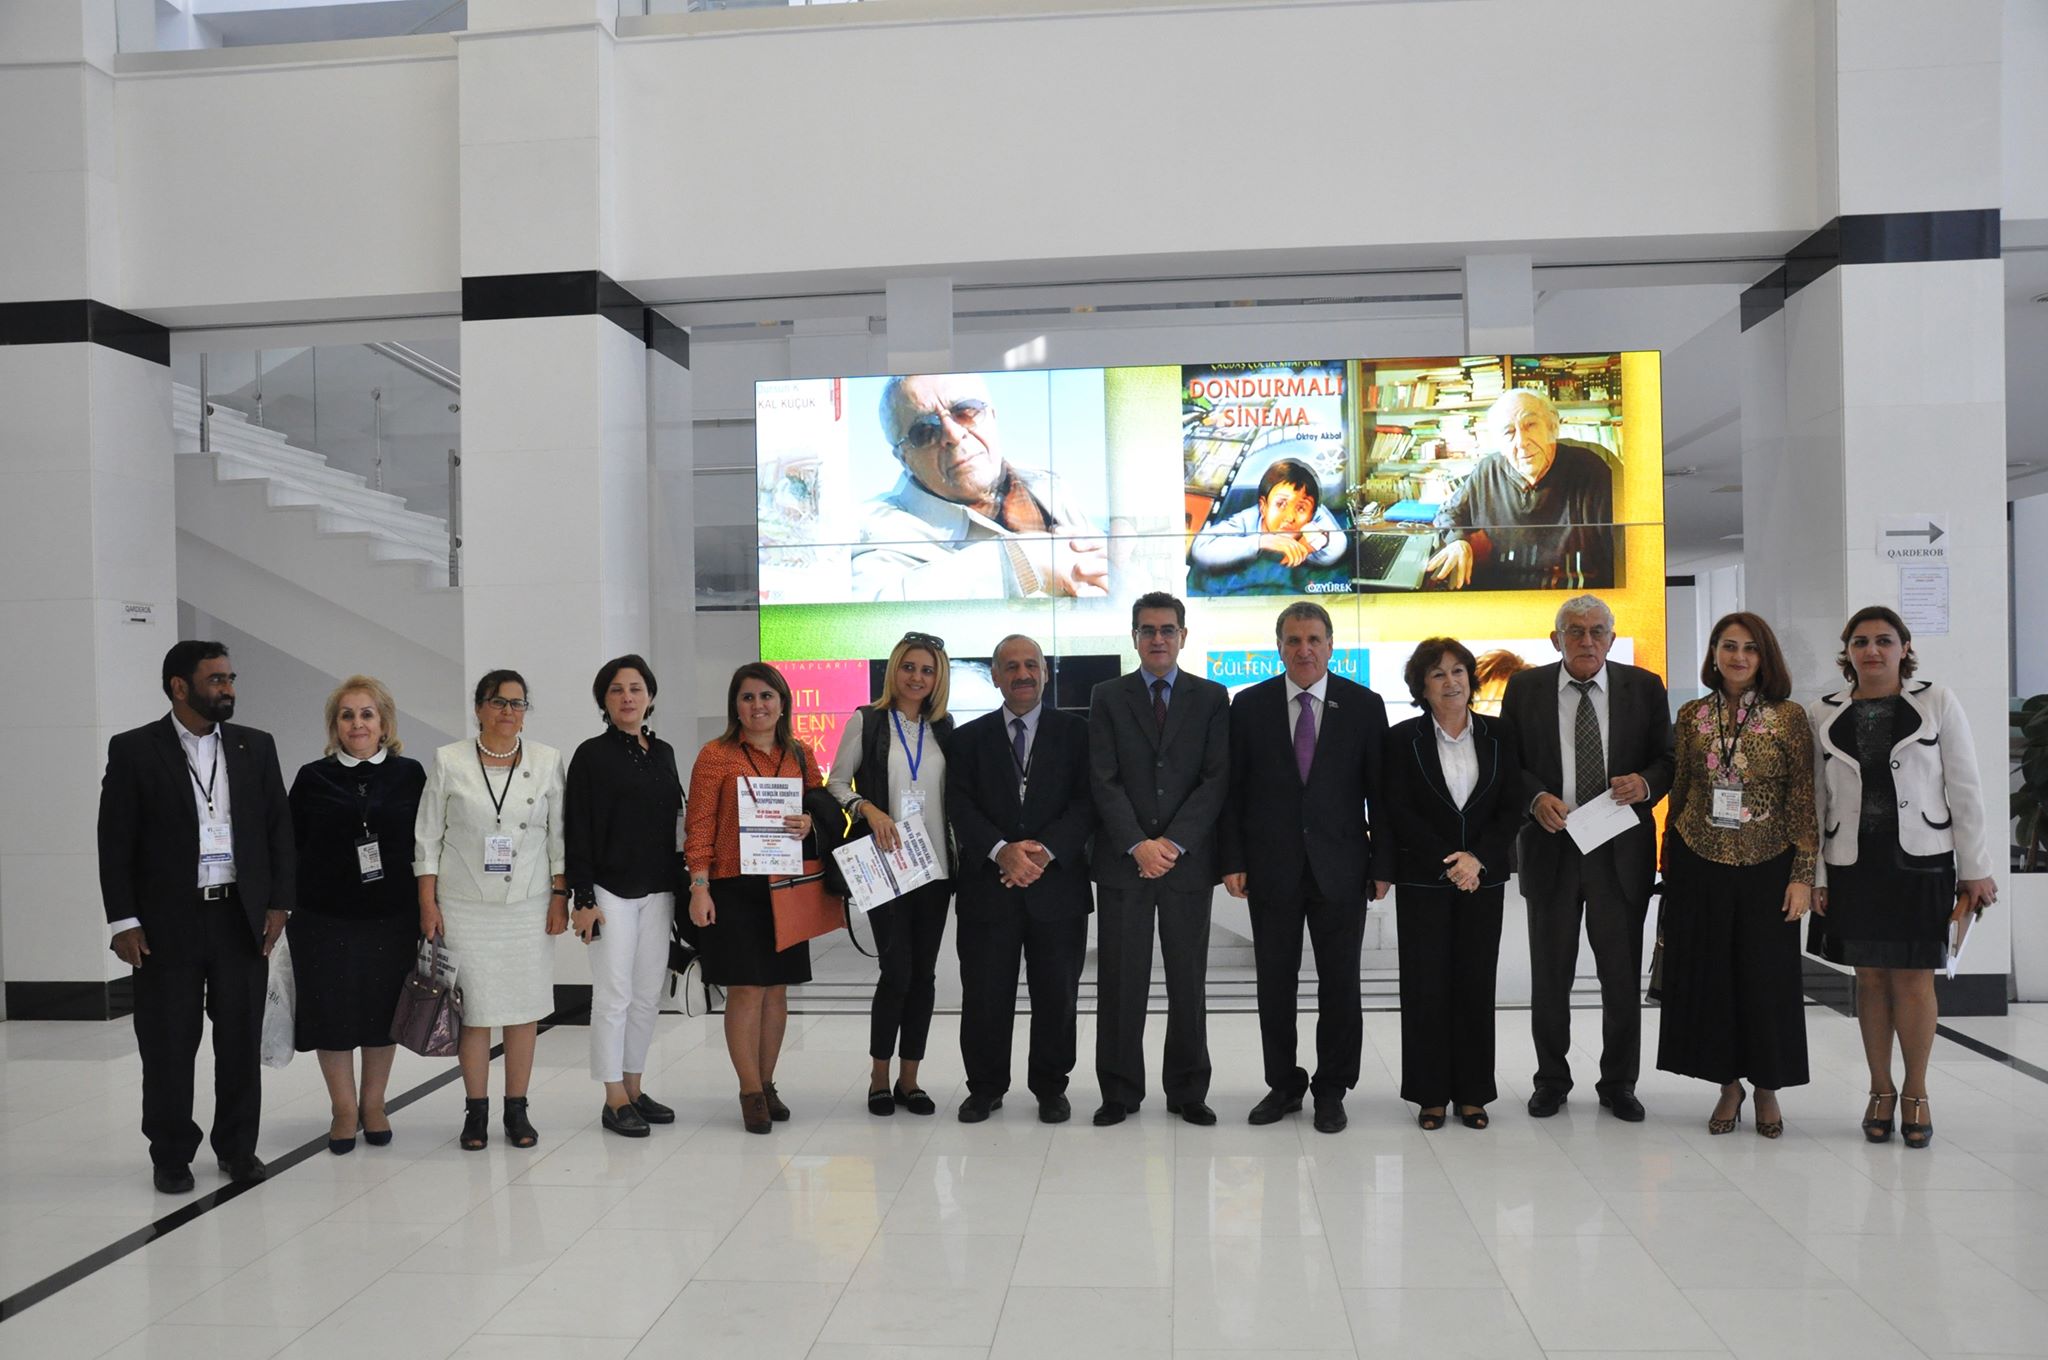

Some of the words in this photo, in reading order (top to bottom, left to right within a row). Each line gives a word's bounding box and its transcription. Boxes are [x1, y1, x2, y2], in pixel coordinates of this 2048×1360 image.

[1189, 375, 1344, 399] DONDURMALI
[1223, 403, 1310, 428] SİNEMA
[1295, 433, 1318, 442] Oktay
[1320, 432, 1342, 440] Akbal
[1887, 548, 1944, 559] QARDEROB
[1212, 657, 1273, 676] GÜLTEN
